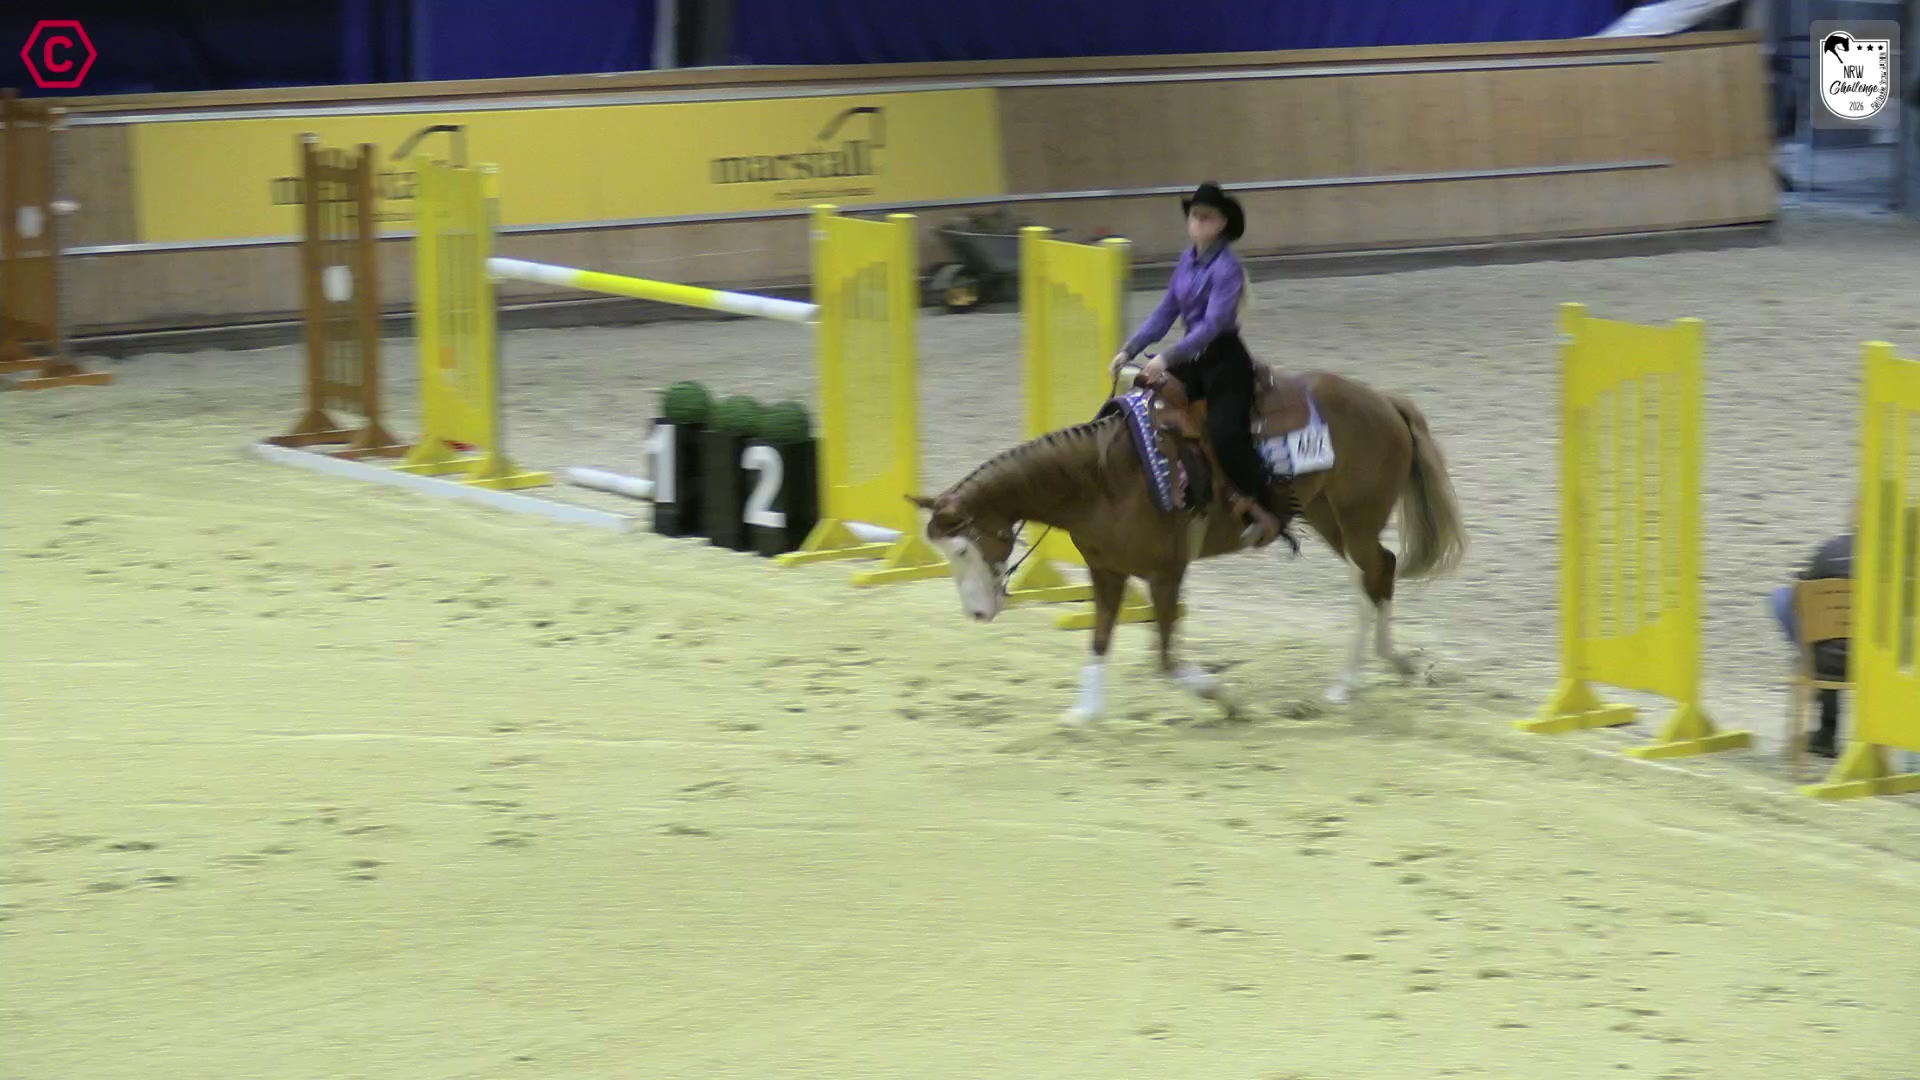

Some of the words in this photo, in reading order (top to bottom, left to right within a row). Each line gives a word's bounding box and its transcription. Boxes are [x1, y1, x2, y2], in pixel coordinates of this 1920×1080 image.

[710, 139, 876, 185] marstall
[646, 423, 676, 503] 1
[740, 445, 787, 528] 2
